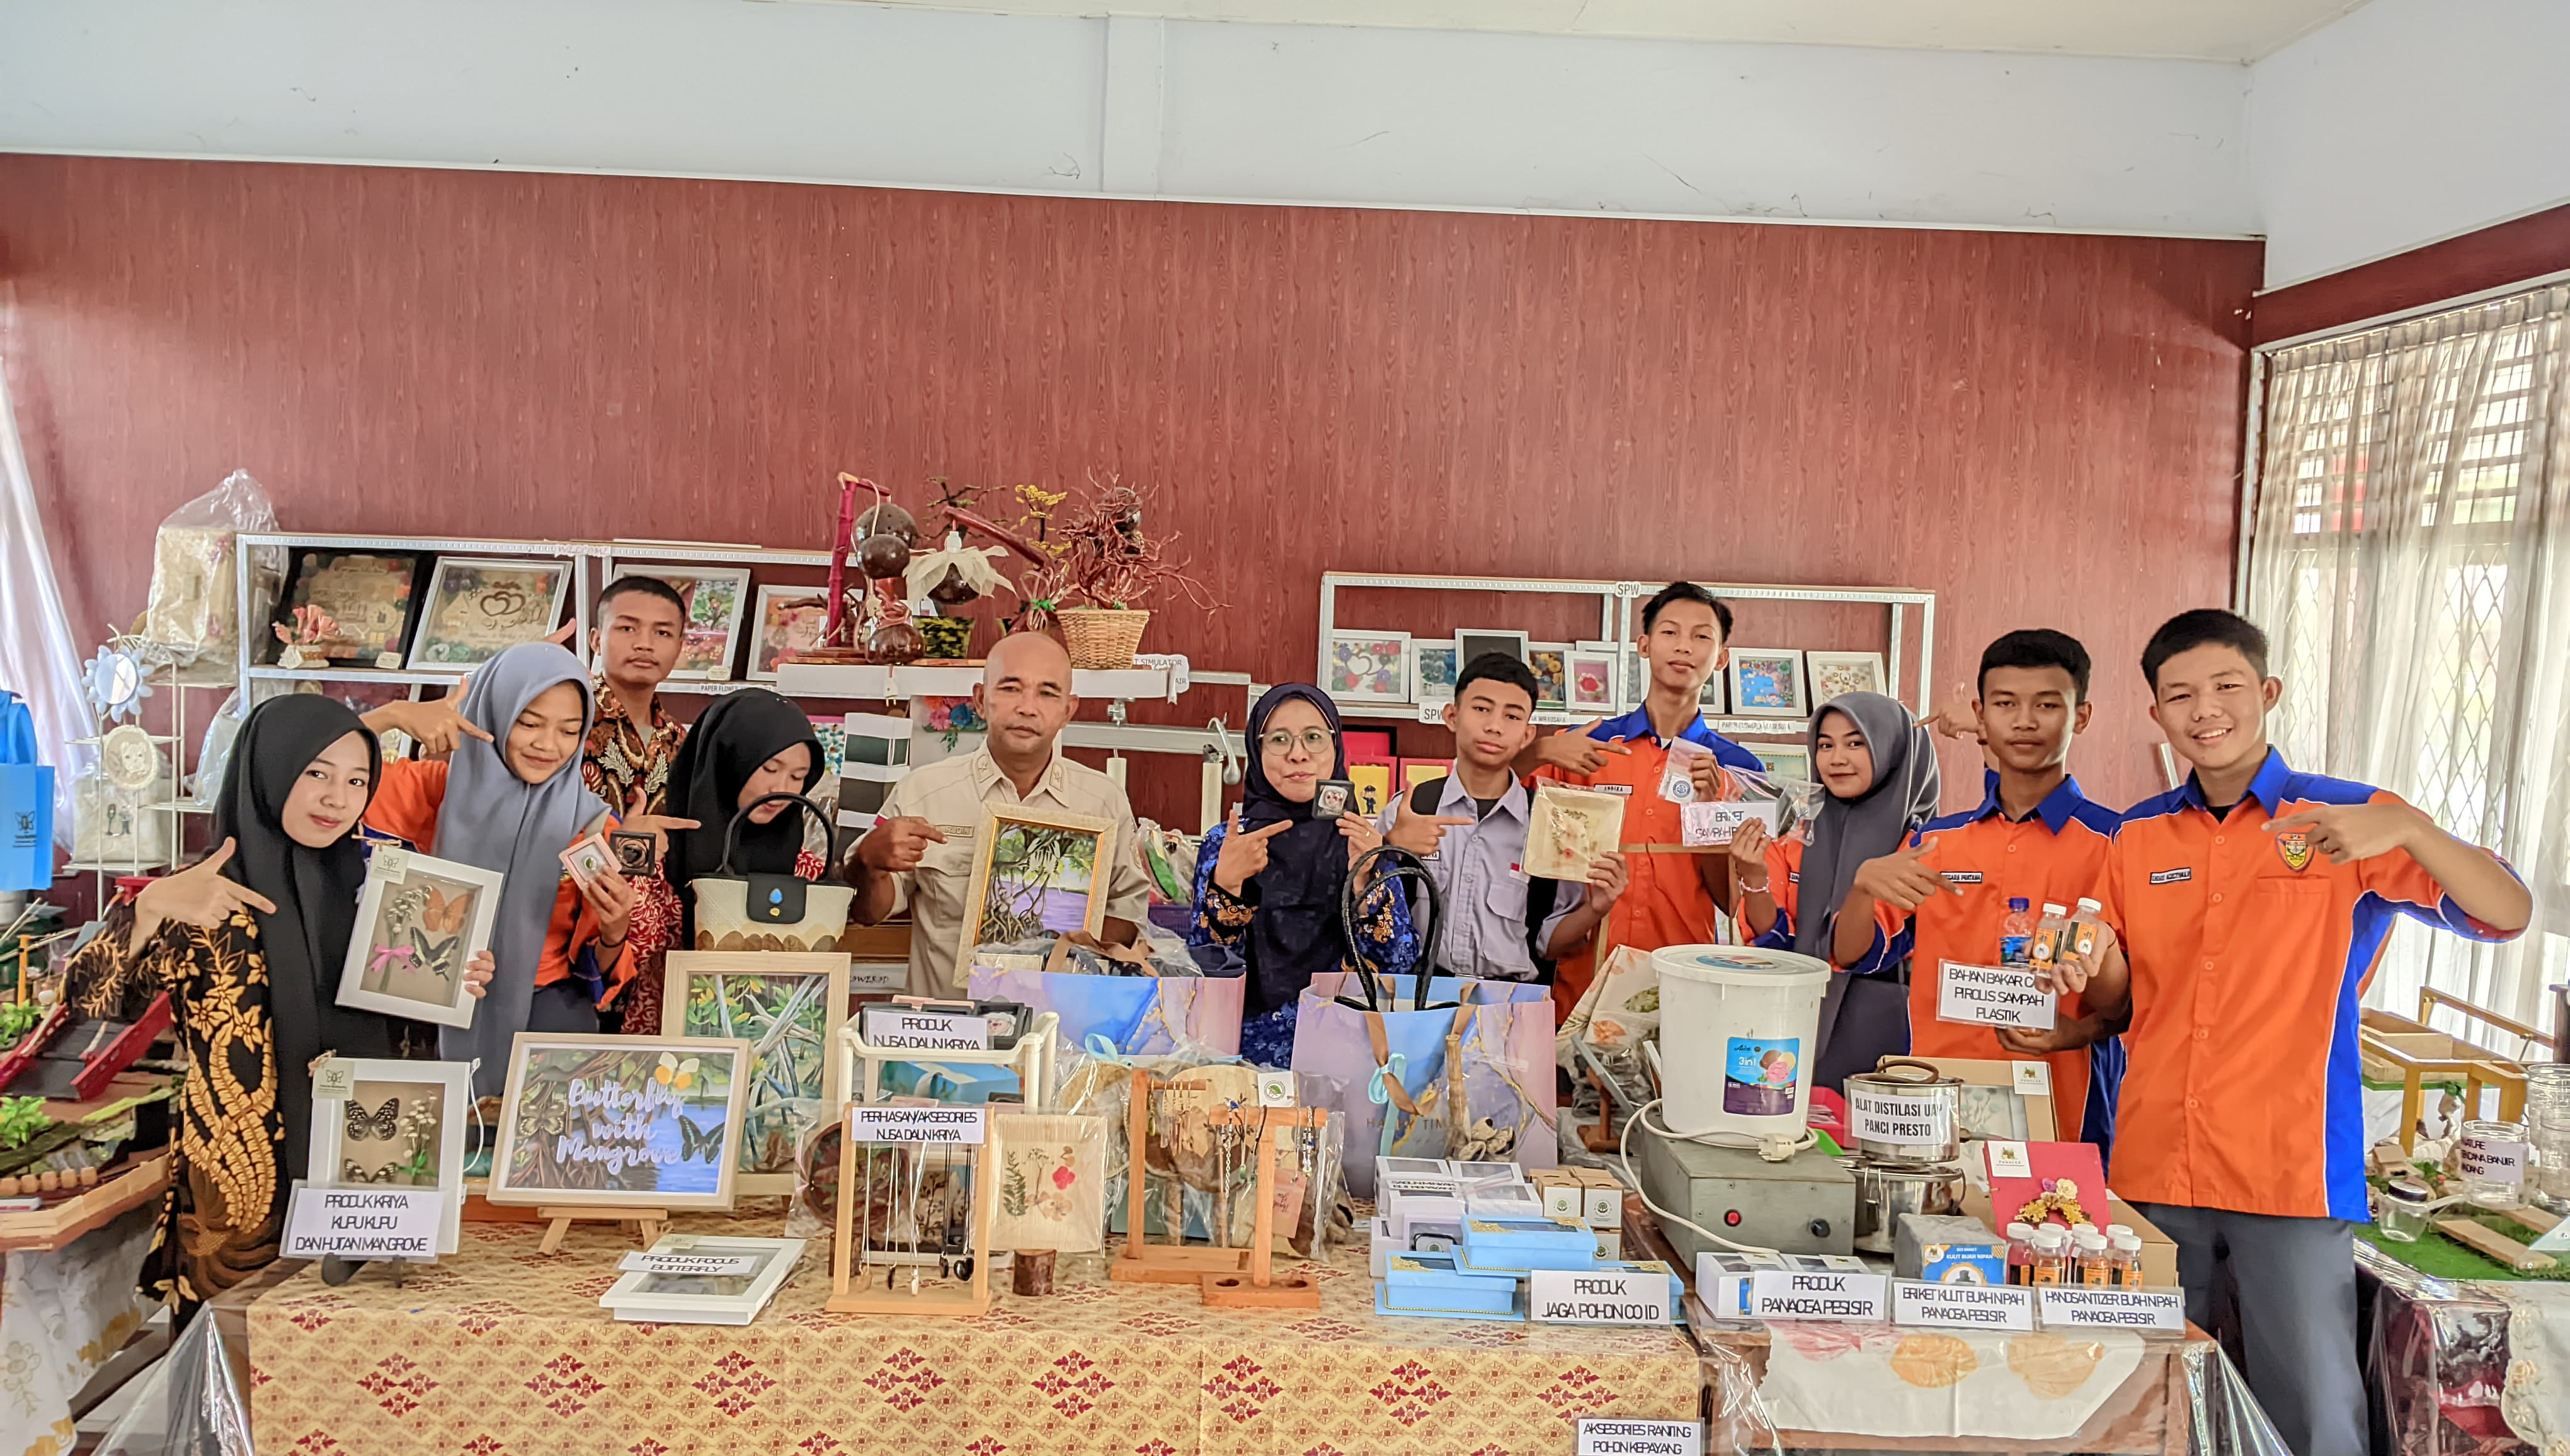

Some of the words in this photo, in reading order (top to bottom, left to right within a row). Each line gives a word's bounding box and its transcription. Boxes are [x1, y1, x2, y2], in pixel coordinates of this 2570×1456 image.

[1618, 584, 1639, 595] SPW
[1949, 968, 1986, 984] BAHAN
[1986, 972, 2023, 987] BAKAR
[1954, 986, 1996, 1002] PIROLIS
[1997, 991, 2045, 1007] SAMPAH
[1975, 1006, 2021, 1023] PLASTIK
[901, 1017, 953, 1032] PRODUK
[873, 1035, 908, 1049] NUSA
[909, 1036, 944, 1050] DAUN
[944, 1038, 981, 1050] KRIYA
[568, 1076, 684, 1120] Butterfly
[1855, 1097, 1872, 1113] ALAT
[1874, 1101, 1921, 1117] DISTILASI
[591, 1112, 656, 1140] with
[1366, 1118, 1415, 1130] HAPY
[1422, 1118, 1448, 1131] TIM
[1865, 1118, 1889, 1135] PANCI
[1892, 1122, 1931, 1137] PRESTO
[876, 1129, 903, 1140] NUSA
[904, 1129, 932, 1141] DAUN
[932, 1129, 962, 1142] KRIYA
[556, 1135, 682, 1176] Mangrove
[2486, 1154, 2515, 1167] BANJIR
[324, 1195, 374, 1209] PRODUK
[374, 1195, 409, 1209] KRIYA
[331, 1215, 365, 1229] KUPU
[365, 1215, 398, 1230] KUPU
[295, 1236, 322, 1251] DAN
[323, 1237, 362, 1251] HUTAN
[362, 1237, 428, 1251] MANGROVE
[641, 1254, 695, 1264] PRODUK
[650, 1264, 723, 1273] BUTTERFLY
[1573, 1278, 1627, 1295] PRODUK
[1791, 1275, 1846, 1292] PRODUK
[1902, 1287, 1937, 1300] BRIKET
[1938, 1288, 1965, 1302] KULIT
[1966, 1290, 1994, 1304] BUAH
[2045, 1290, 2120, 1306] HANDSANITIZER
[2120, 1294, 2148, 1307] BUAH
[1541, 1302, 1577, 1318] JAGA
[1578, 1302, 1624, 1319] POHON
[1624, 1304, 1643, 1319] CO
[1645, 1304, 1660, 1321] ID
[1761, 1297, 1823, 1314] PANACEA
[1822, 1299, 1874, 1316] PESISIR
[1922, 1306, 1968, 1321] PANACEA
[1968, 1309, 2007, 1323] PESISIR
[2070, 1310, 2118, 1324] PANACEA
[2117, 1311, 2157, 1326] PESISIR
[1583, 1423, 1647, 1436] AKSESORIES
[1647, 1425, 1692, 1438] RANTING
[1592, 1440, 1629, 1453] POHON
[1629, 1442, 1682, 1455] KEPAYANG
